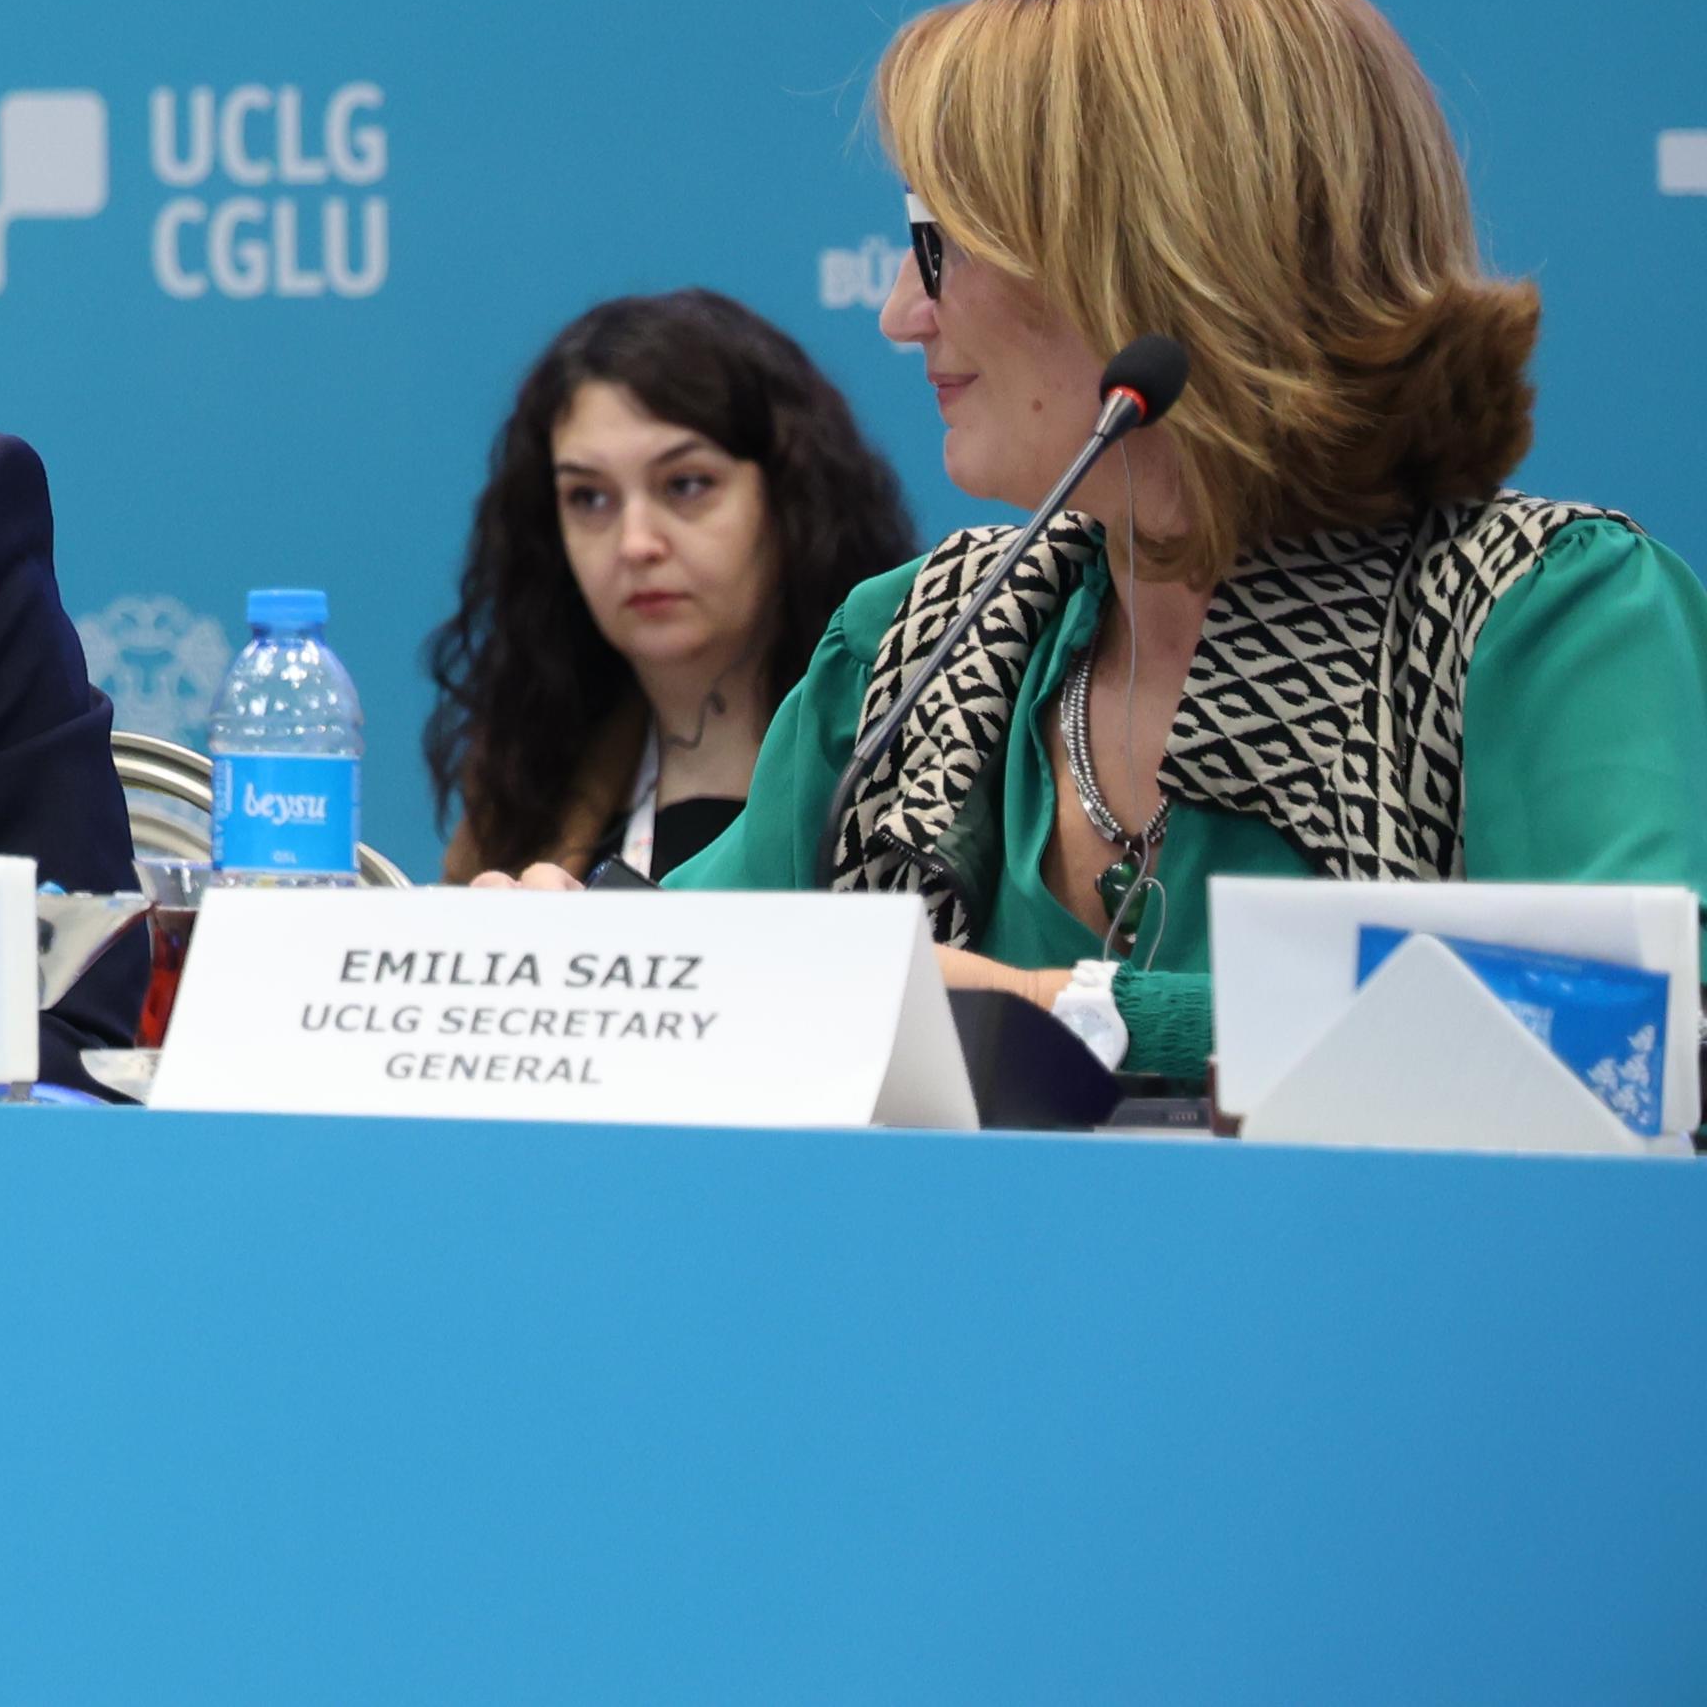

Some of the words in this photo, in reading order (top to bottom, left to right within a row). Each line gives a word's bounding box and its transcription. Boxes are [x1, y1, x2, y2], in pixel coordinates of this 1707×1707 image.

[150, 82, 389, 186] UCLG
[151, 195, 389, 298] CGLU
[244, 783, 326, 825] beysu
[339, 949, 541, 987] EMILIA
[564, 953, 703, 990] SAIZ
[301, 1003, 420, 1034] UCLG
[437, 1006, 718, 1040] SECRETARY
[385, 1052, 602, 1085] GENERAL
